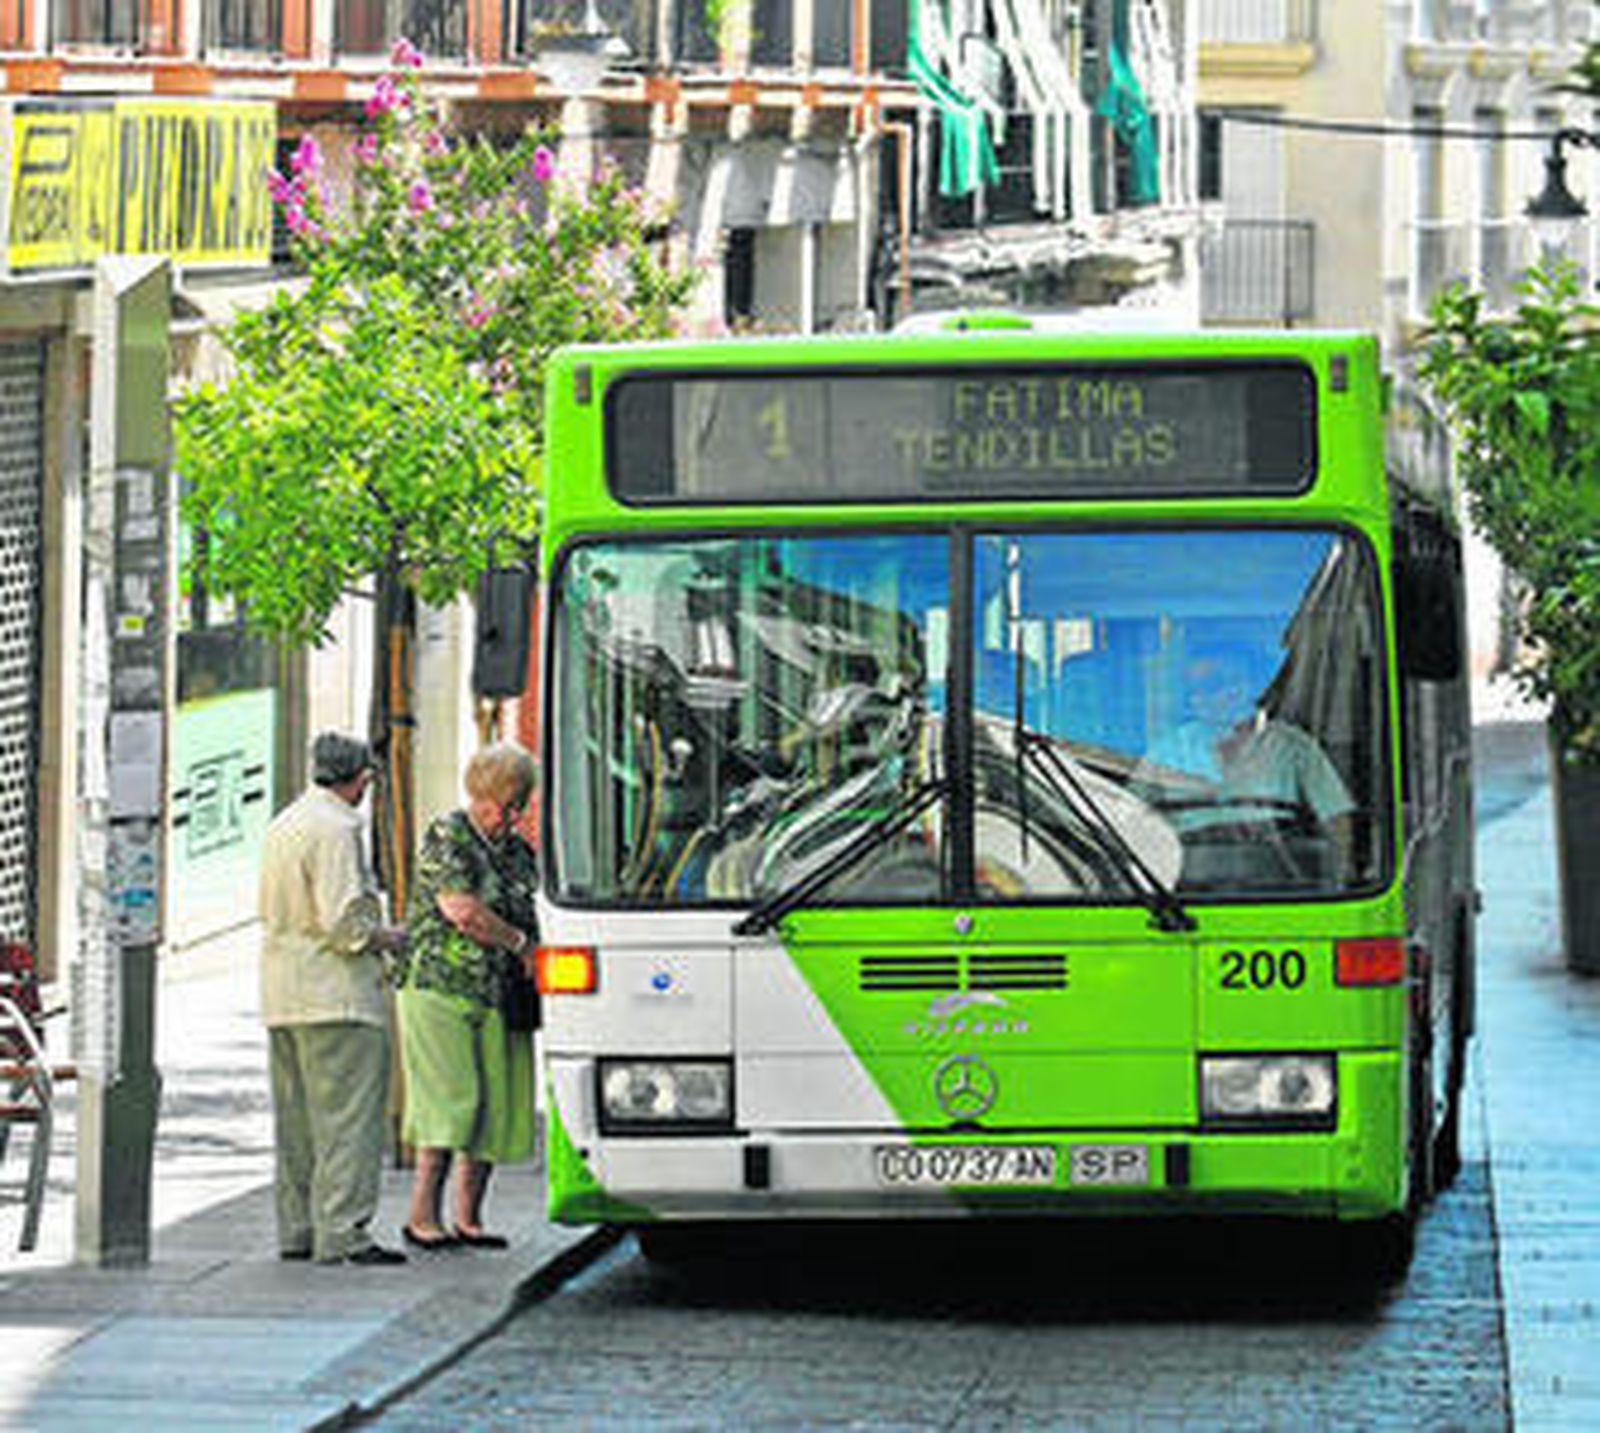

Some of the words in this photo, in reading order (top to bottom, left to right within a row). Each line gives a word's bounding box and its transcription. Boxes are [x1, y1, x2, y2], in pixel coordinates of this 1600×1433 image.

[954, 379, 1143, 420] FATIMA
[757, 396, 793, 459] 1
[895, 421, 1176, 469] TENDILLAS
[1221, 949, 1306, 989] 200
[1081, 1149, 1139, 1180] SP
